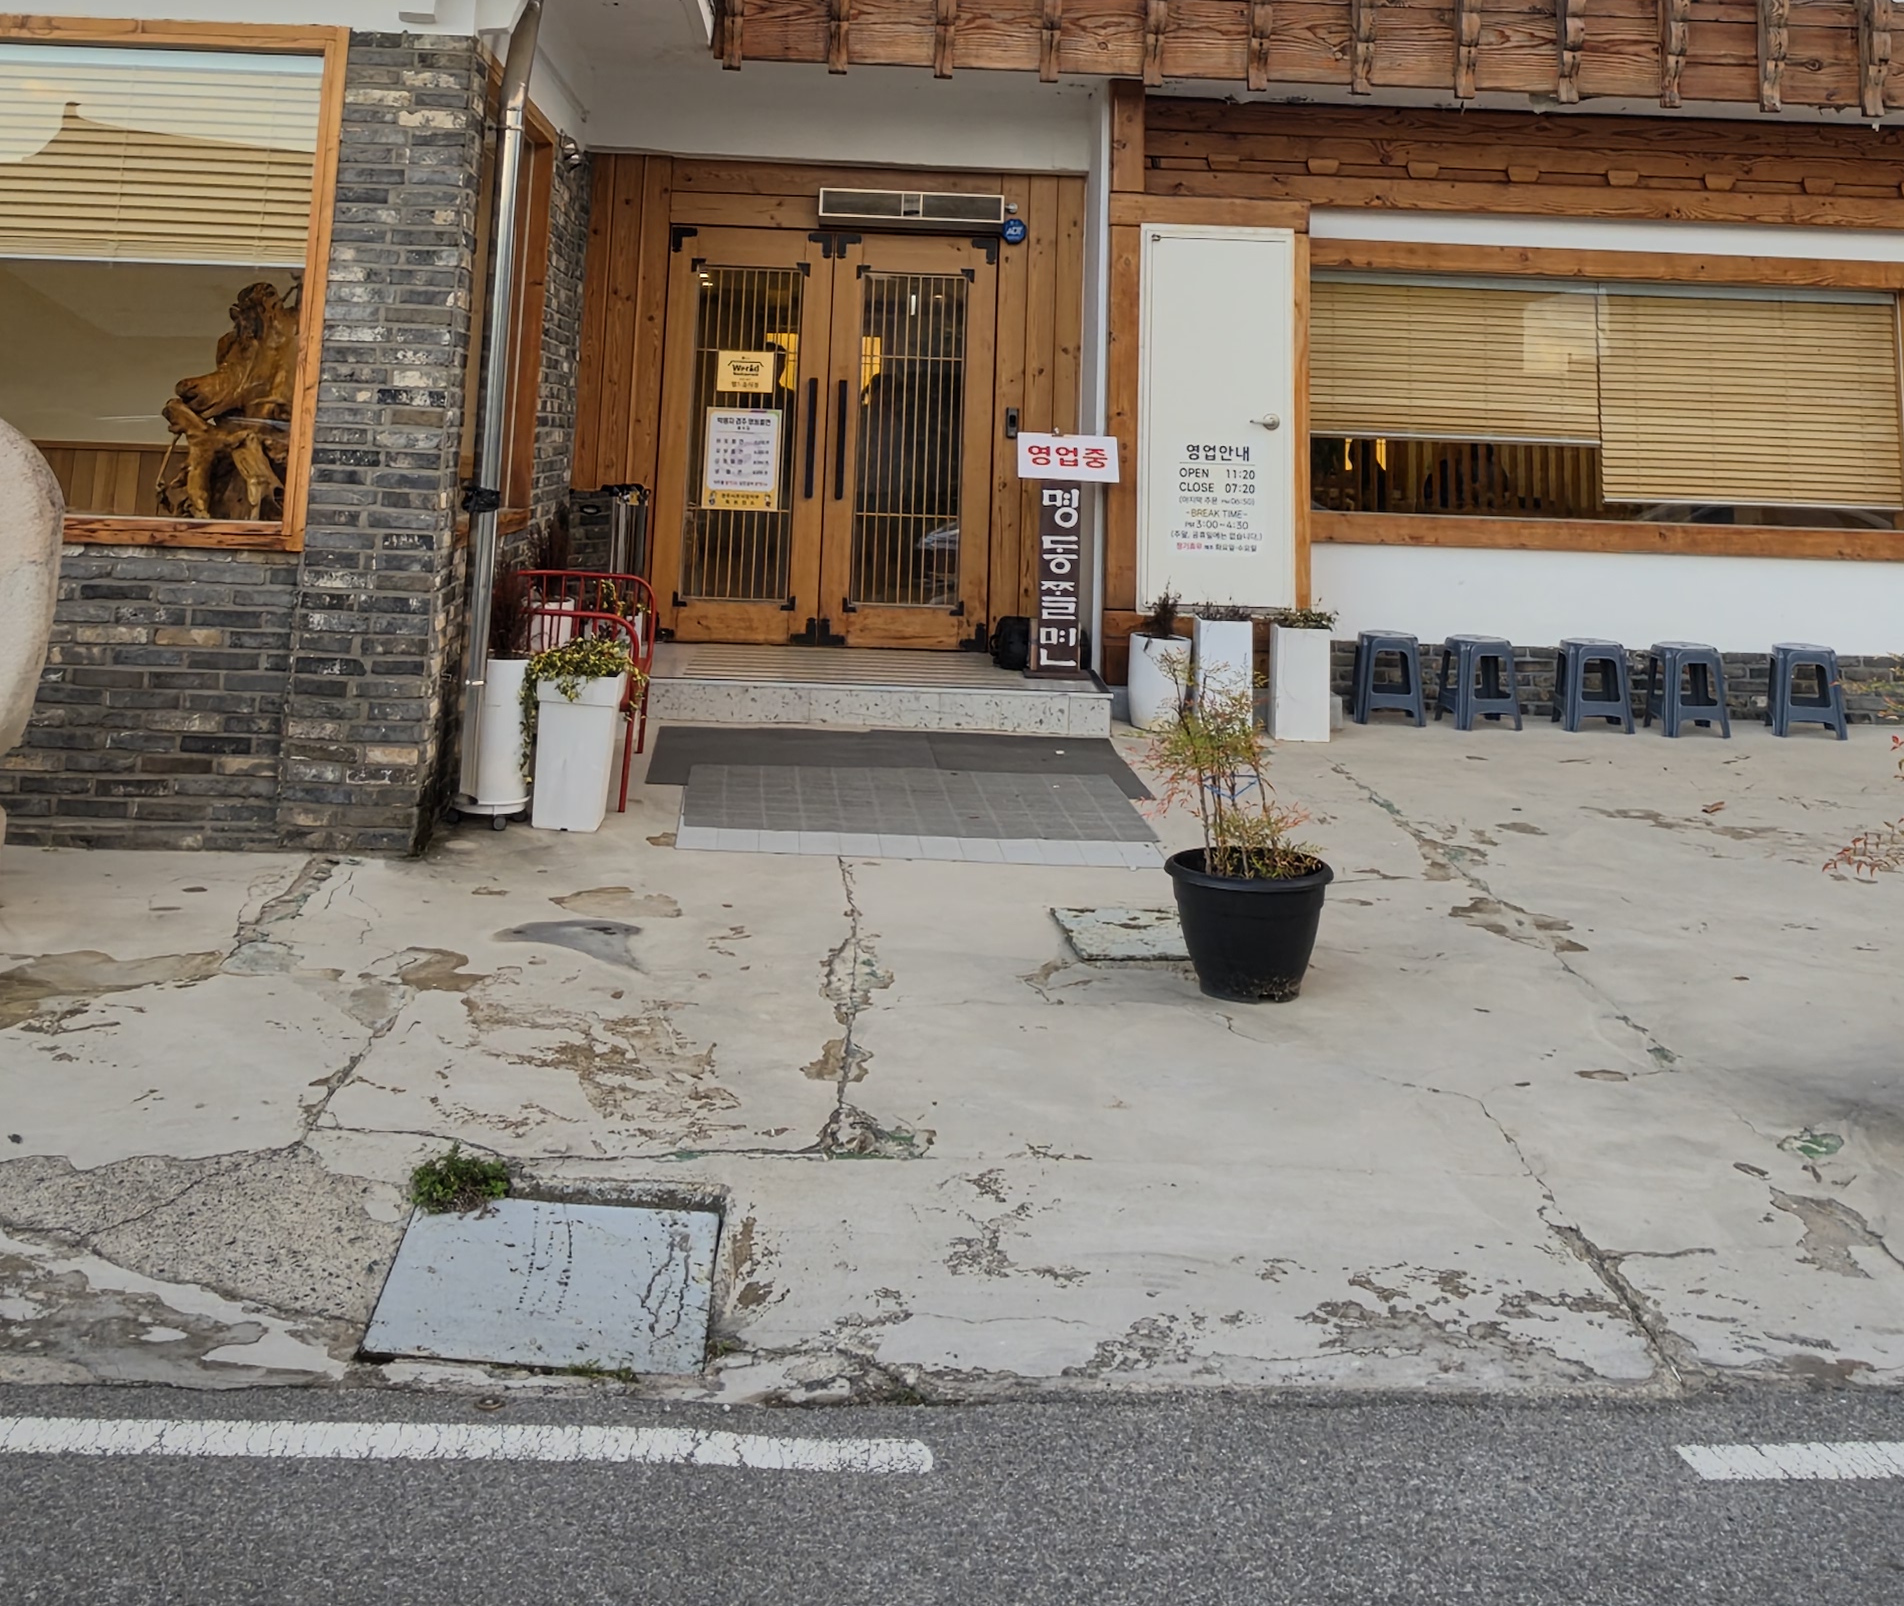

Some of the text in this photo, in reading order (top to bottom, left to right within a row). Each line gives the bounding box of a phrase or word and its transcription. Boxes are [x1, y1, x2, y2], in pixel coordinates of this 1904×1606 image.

[1028, 445, 1108, 470] 영업중
[1186, 444, 1249, 462] 영업안내
[1179, 467, 1255, 480] OPEN 11:20
[1179, 481, 1255, 494] CLOSE 07:20
[1040, 489, 1080, 667] 명동쫄면
